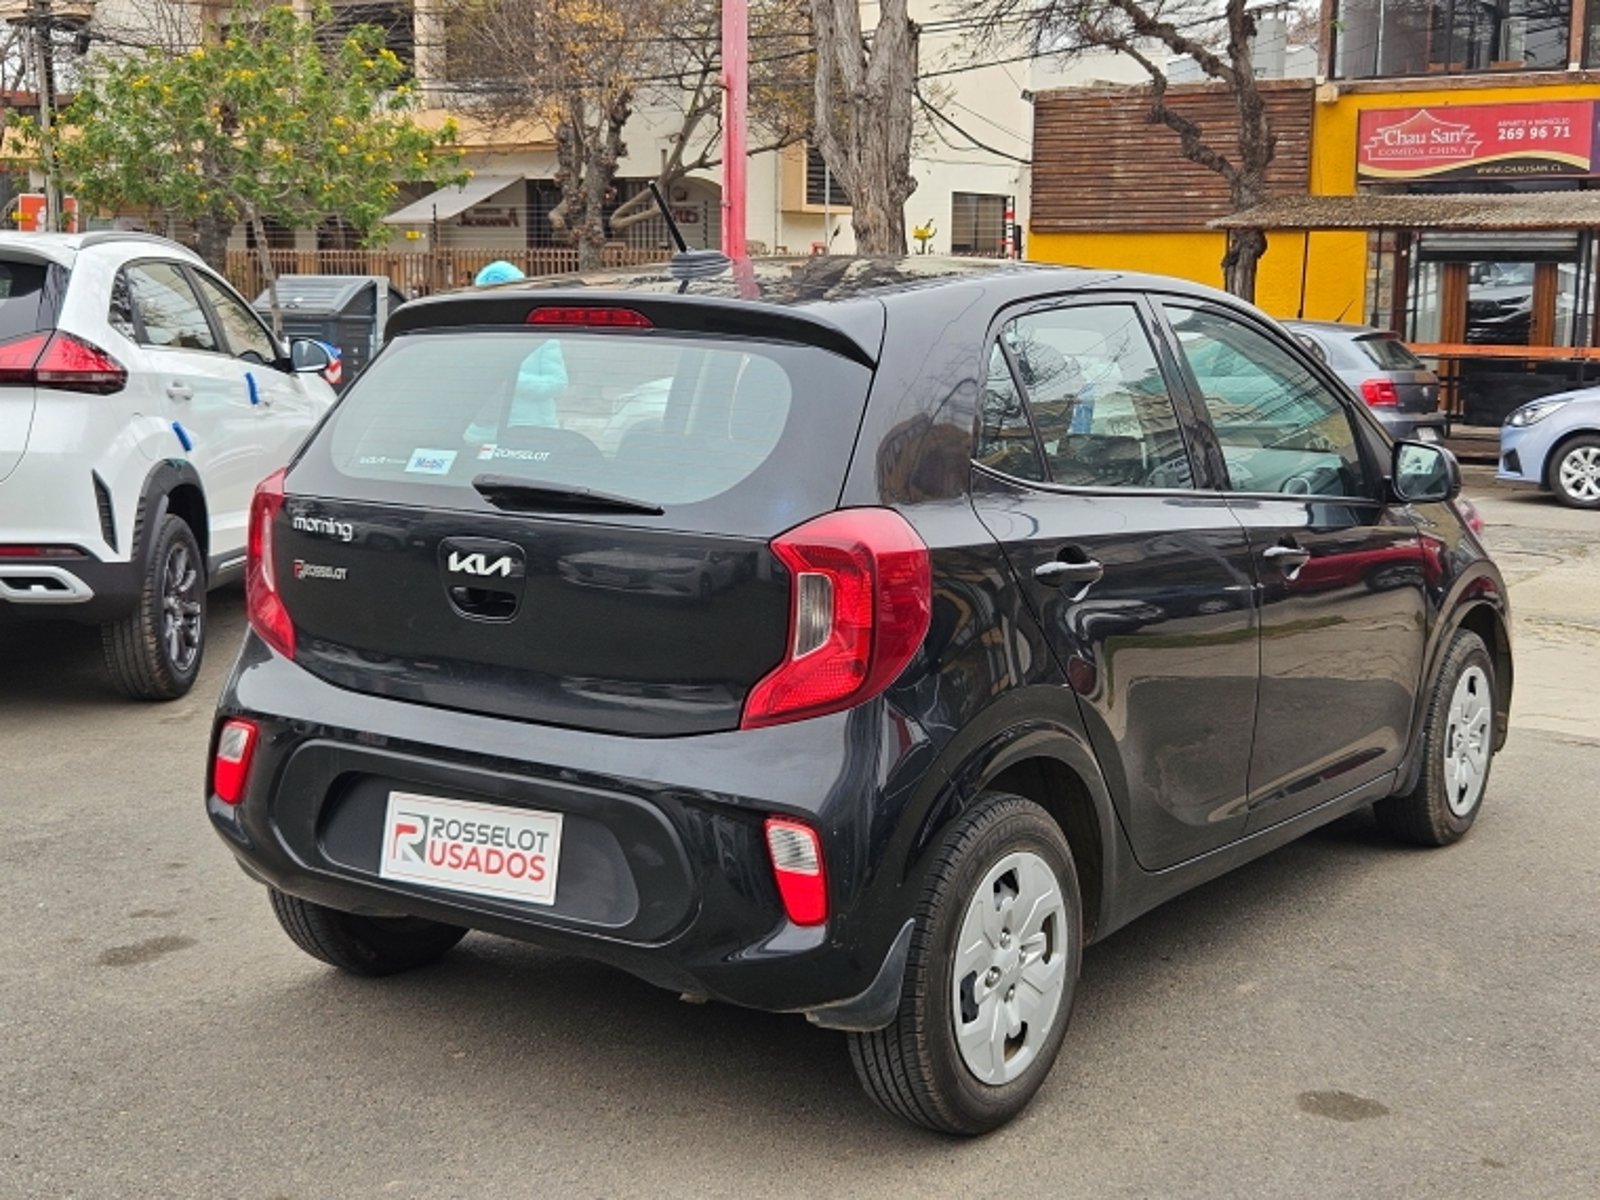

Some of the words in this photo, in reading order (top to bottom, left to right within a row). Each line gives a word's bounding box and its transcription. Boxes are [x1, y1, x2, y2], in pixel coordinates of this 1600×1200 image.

[1384, 128, 1426, 146] Chau
[1498, 127, 1524, 140] 269
[1530, 126, 1548, 139] 96
[1553, 125, 1571, 138] 71
[1378, 147, 1424, 157] COMIDA
[1428, 146, 1467, 155] CHINA
[293, 516, 353, 542] morning
[431, 817, 549, 853] ROSSELOT
[429, 839, 546, 882] USADOS
